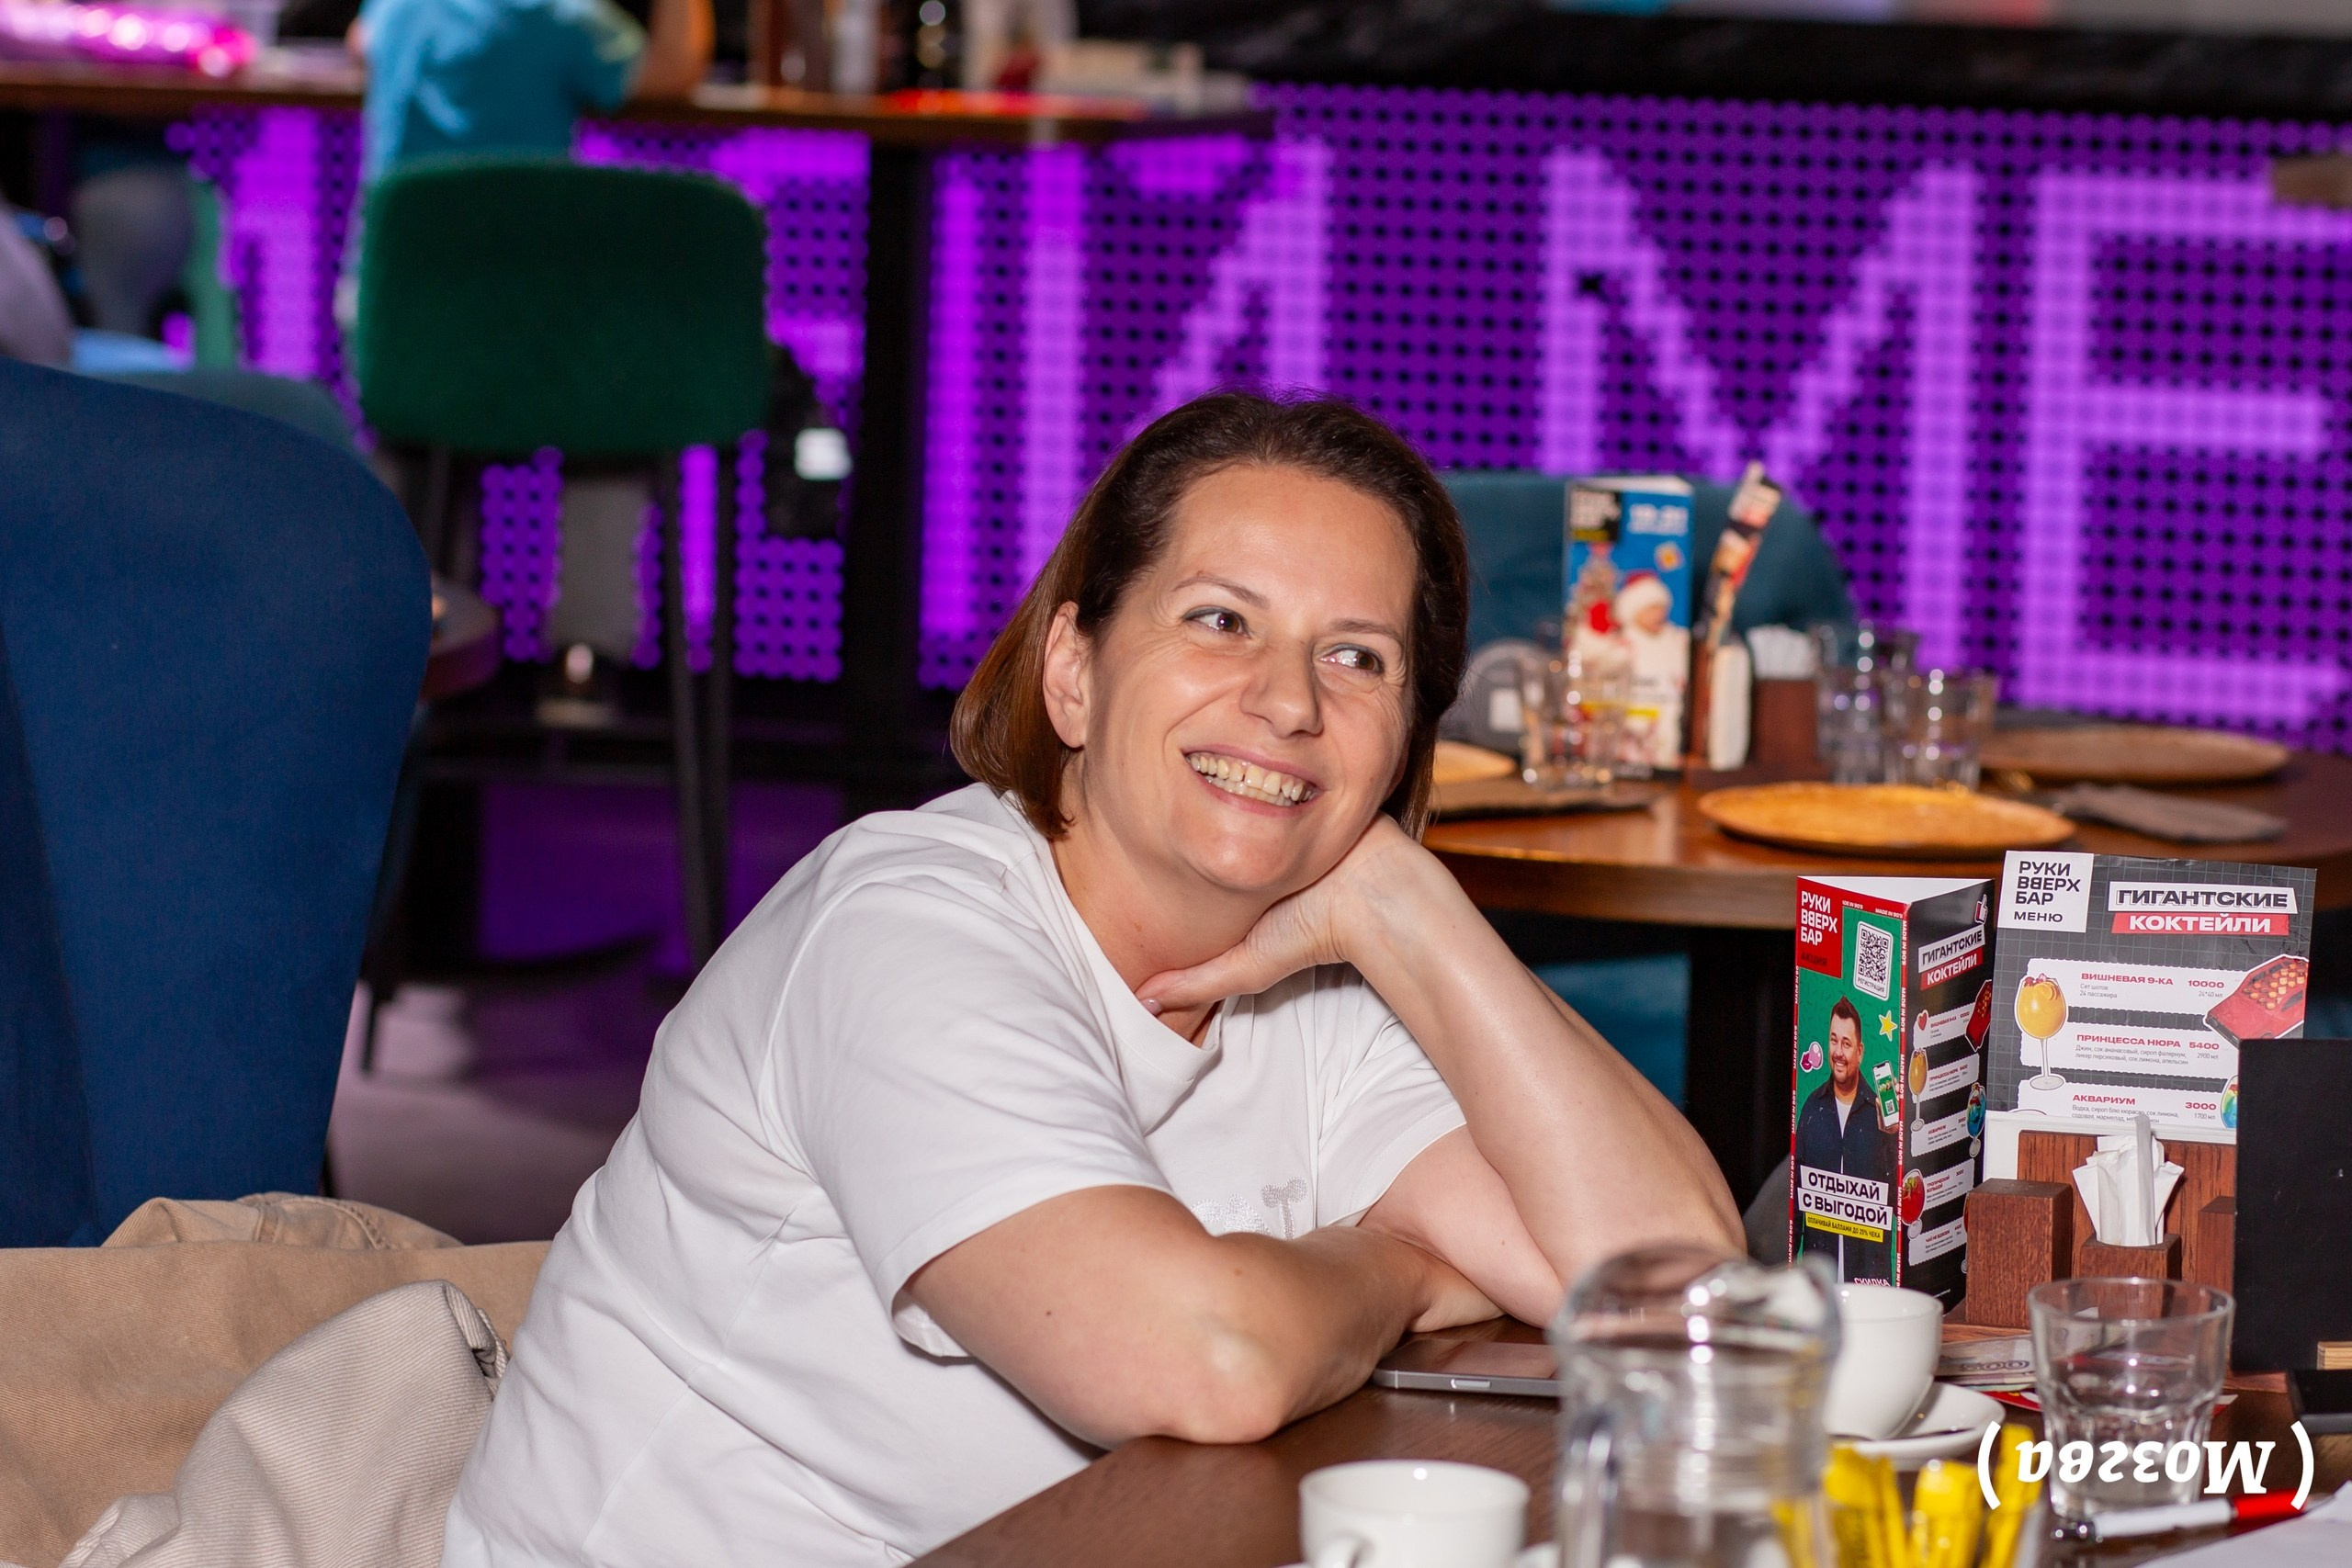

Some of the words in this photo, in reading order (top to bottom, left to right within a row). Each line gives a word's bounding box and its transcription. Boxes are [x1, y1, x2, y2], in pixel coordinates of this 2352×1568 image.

[2019, 861, 2071, 876] РУКИ
[2018, 876, 2081, 892] ВВЕРХ
[1802, 890, 1830, 913] РУКИ
[2016, 891, 2053, 906] БАР
[2116, 889, 2289, 908] ГИГАНТСКИЕ
[1801, 908, 1838, 933] ВВЕРХ
[2014, 911, 2063, 923] МЕНЮ
[2130, 913, 2271, 933] КОКТЕЙЛИ
[1801, 927, 1823, 946] БАР
[1922, 930, 1982, 965] ГИГАНТСКИЕ
[1927, 953, 1977, 985] КОКТЕЙЛИ
[1858, 976, 1884, 992] РЕГИСТРАЦИЯ
[2082, 973, 2145, 984] ВИШНЕВАЯ
[2147, 977, 2173, 986] 9-КА
[2188, 980, 2224, 988] 10000
[2075, 1044, 2092, 1053] Джин,
[2077, 1034, 2145, 1045] ПРИНЦЕССА
[2147, 1039, 2181, 1047] НЮРА
[2189, 1042, 2219, 1050] 5400
[2073, 1095, 2135, 1105] АКВАРИУМ
[1808, 1171, 1880, 1201] ОТДЫХАЙ
[1803, 1193, 1812, 1207] С
[1815, 1195, 1887, 1225] ВЫГОДОЙ
[1807, 1216, 1831, 1227] ОПЛАЧИВАЙ
[1831, 1223, 1852, 1232] БАЛЛАМИ
[1852, 1226, 1859, 1235] ДО
